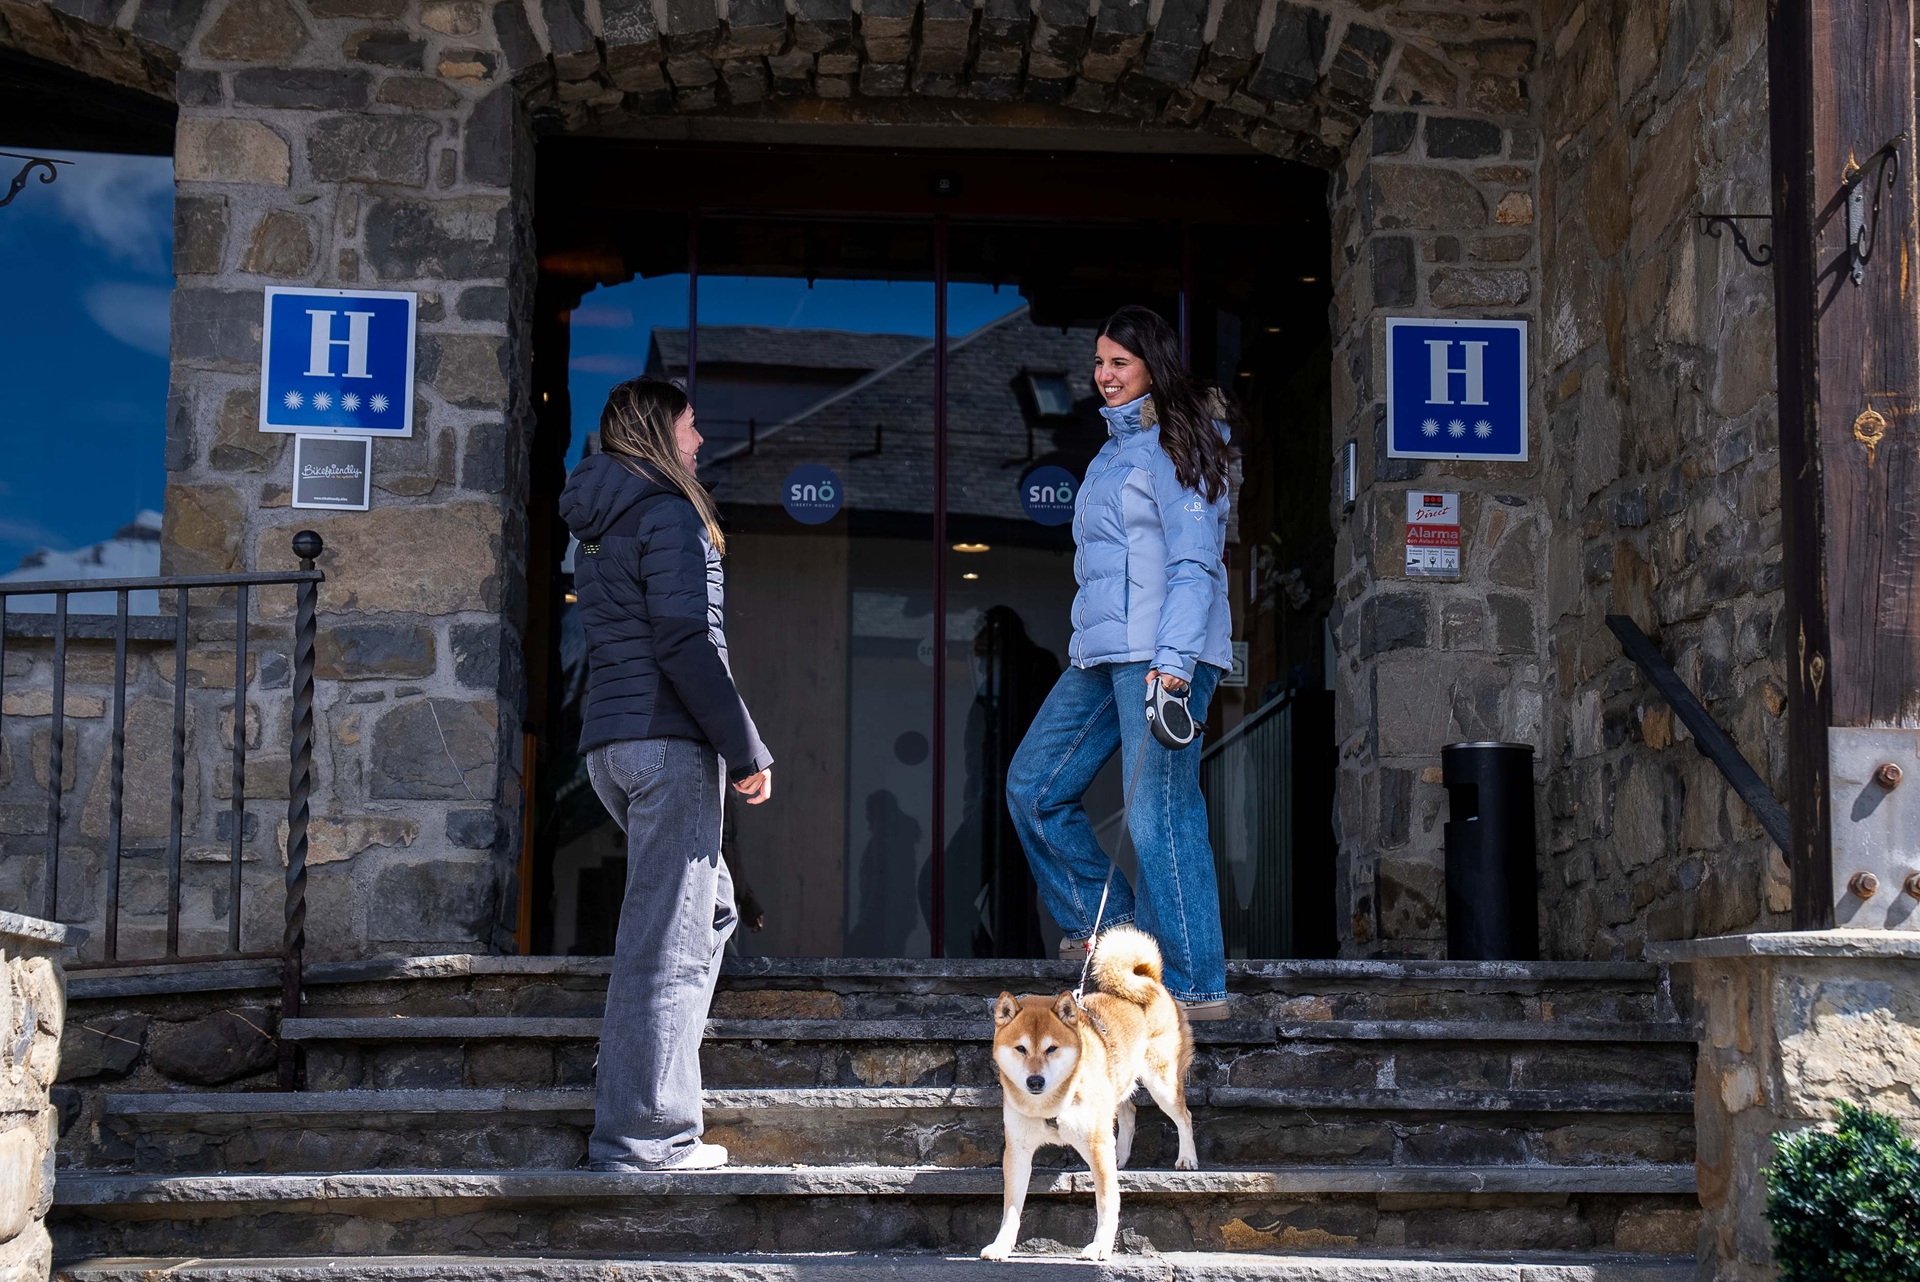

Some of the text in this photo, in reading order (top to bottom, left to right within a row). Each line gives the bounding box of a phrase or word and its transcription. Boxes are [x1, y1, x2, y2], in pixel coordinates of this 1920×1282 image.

[303, 309, 375, 378] H
[1424, 340, 1489, 405] H
[302, 463, 362, 478] Bikefriendly
[791, 480, 835, 502] snö
[1029, 482, 1073, 503] snö
[1416, 507, 1452, 520] Direct
[1407, 527, 1458, 539] Alarma
